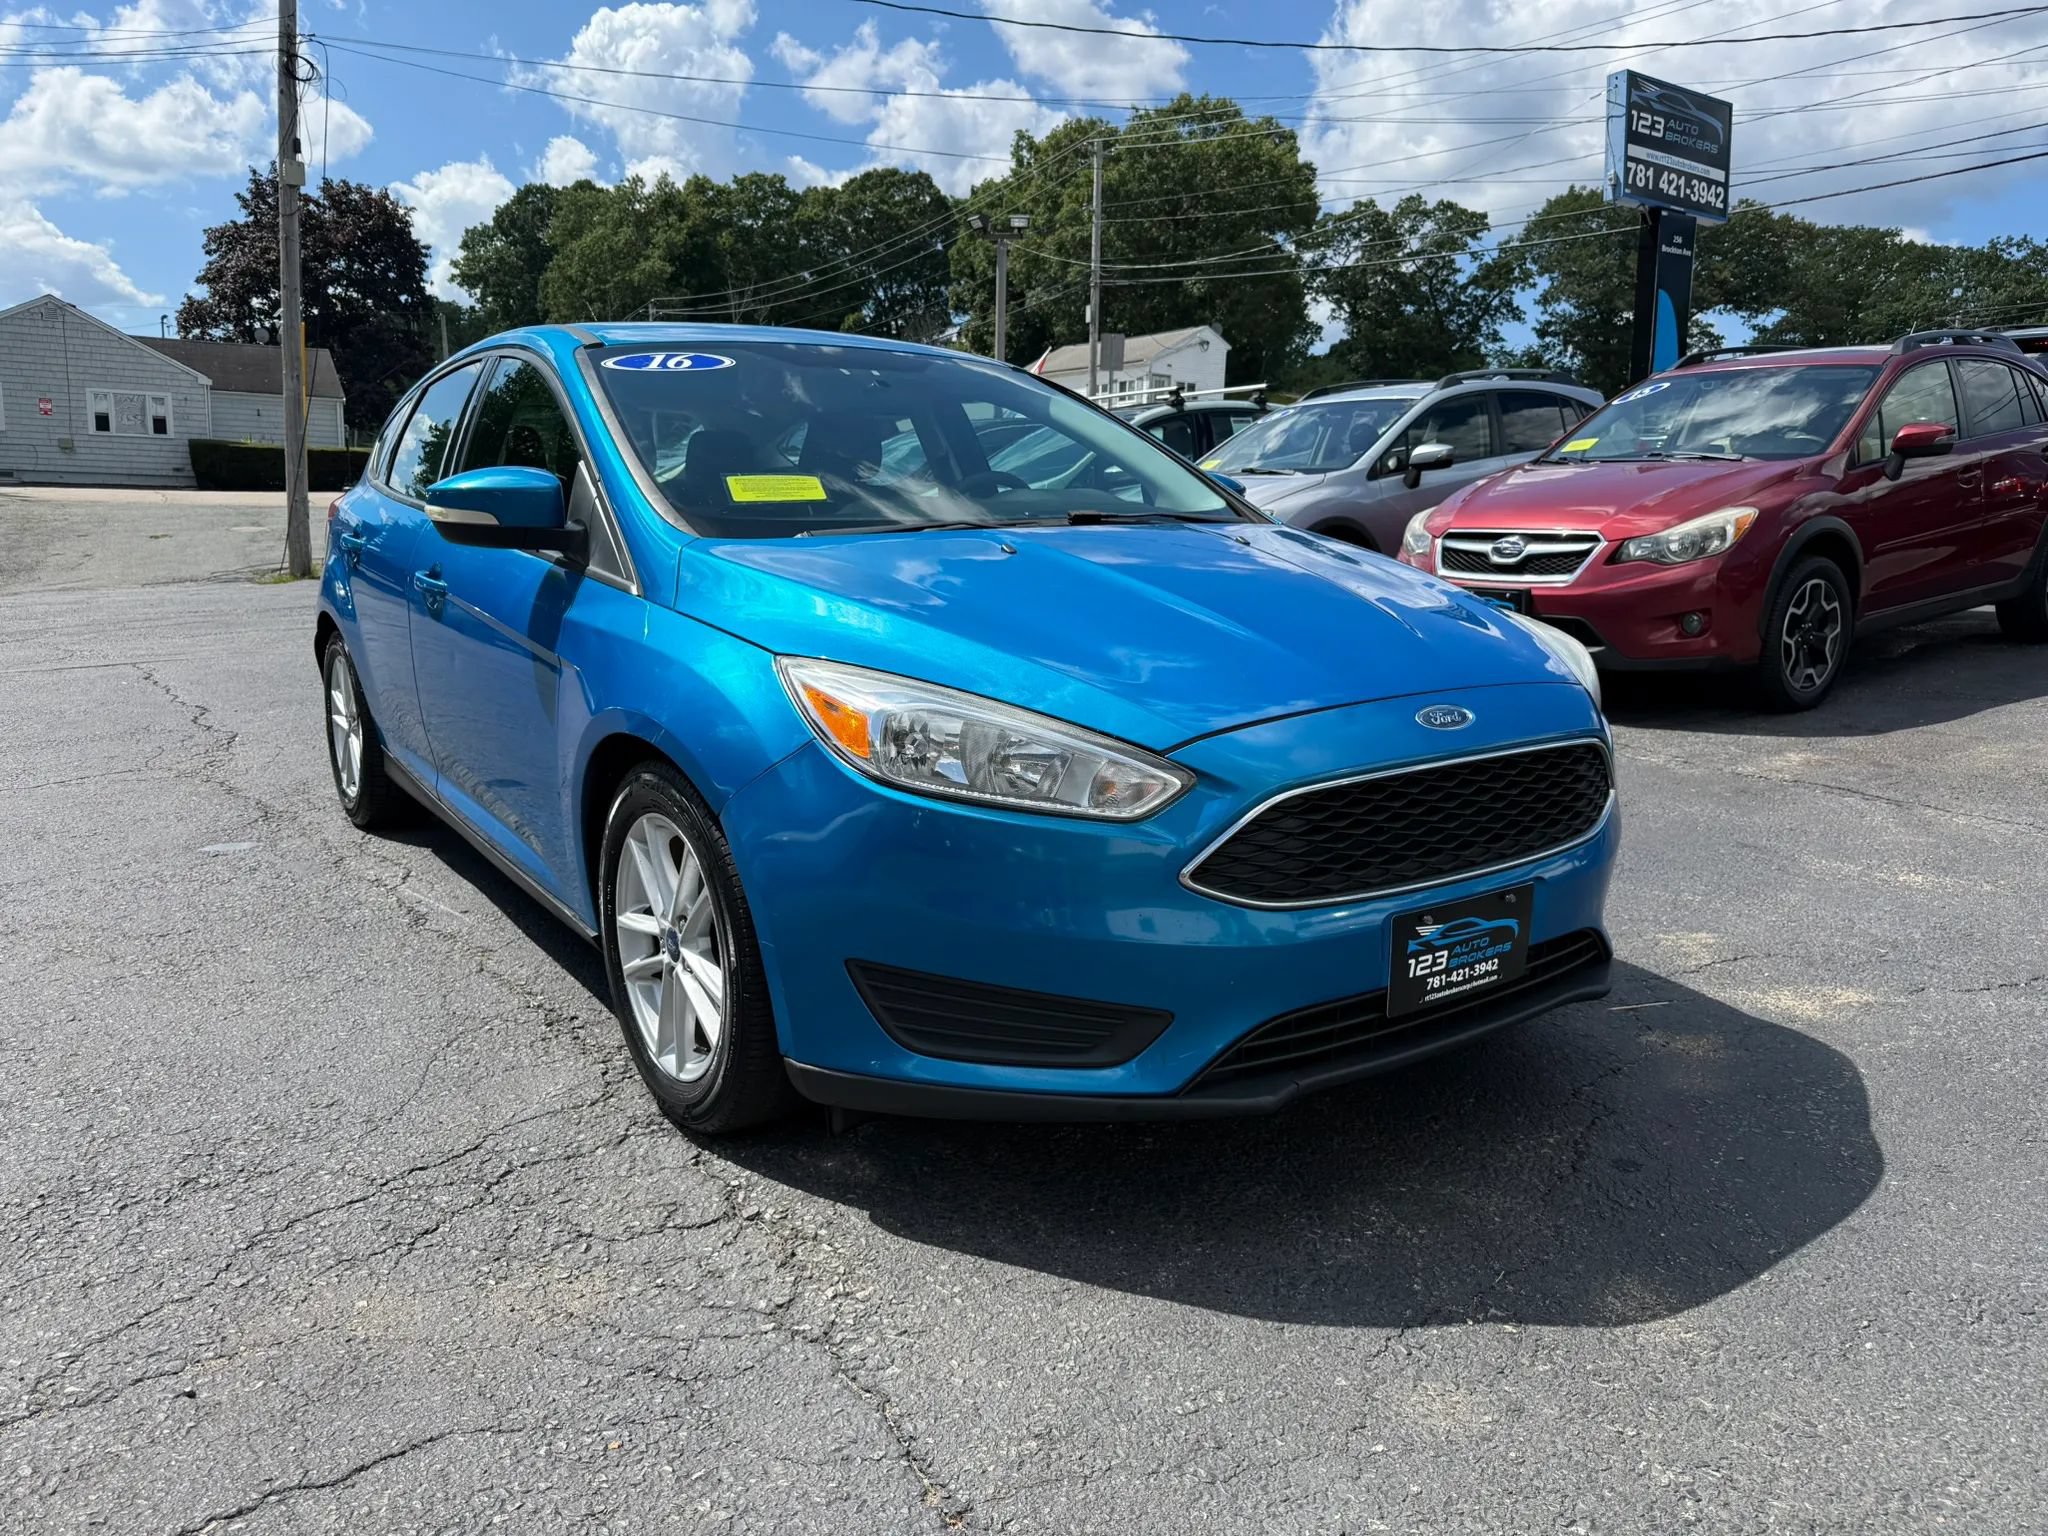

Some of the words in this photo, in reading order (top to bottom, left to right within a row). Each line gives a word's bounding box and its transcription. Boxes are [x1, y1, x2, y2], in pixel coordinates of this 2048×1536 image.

[1631, 109, 1665, 138] 123
[1667, 118, 1699, 135] AUTO
[1664, 131, 1719, 154] BROKERS
[1627, 161, 1654, 190] 781
[1658, 170, 1725, 209] 421-3942
[1661, 244, 1682, 255] Brockton
[1682, 248, 1692, 257] Ave
[644, 353, 696, 370] 16
[1429, 709, 1462, 725] Ford
[1448, 941, 1513, 969] BROKERS
[1451, 936, 1490, 956] AUTO
[1408, 949, 1448, 978] 123
[1426, 958, 1499, 991] 781-421-3942
